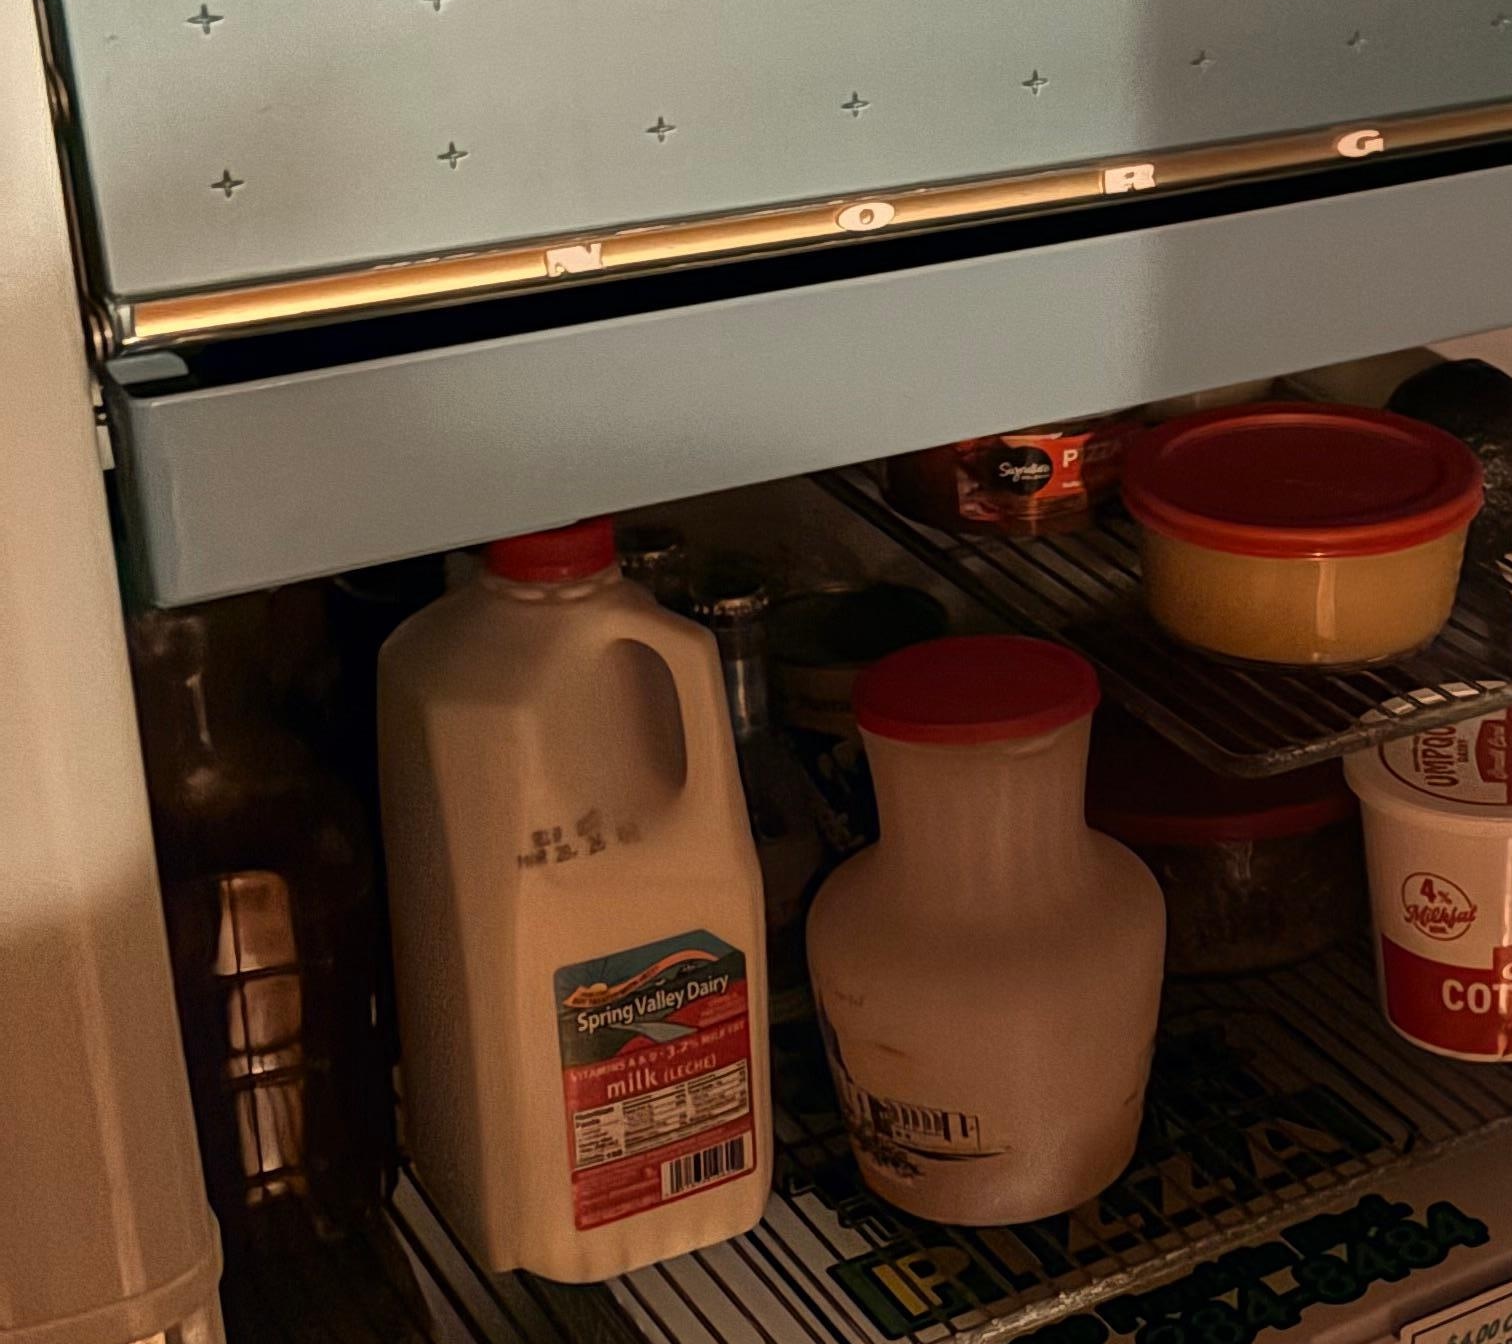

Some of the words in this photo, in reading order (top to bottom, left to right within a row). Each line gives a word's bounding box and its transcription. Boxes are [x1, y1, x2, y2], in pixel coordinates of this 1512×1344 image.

[1420, 878, 1453, 904] 4%
[1403, 902, 1478, 930] Milkfat
[576, 1002, 635, 1035] Spring
[634, 986, 686, 1016] Valley
[686, 974, 730, 1001] Dairy
[606, 1067, 660, 1100] milk
[664, 1053, 718, 1084] (LECHE)
